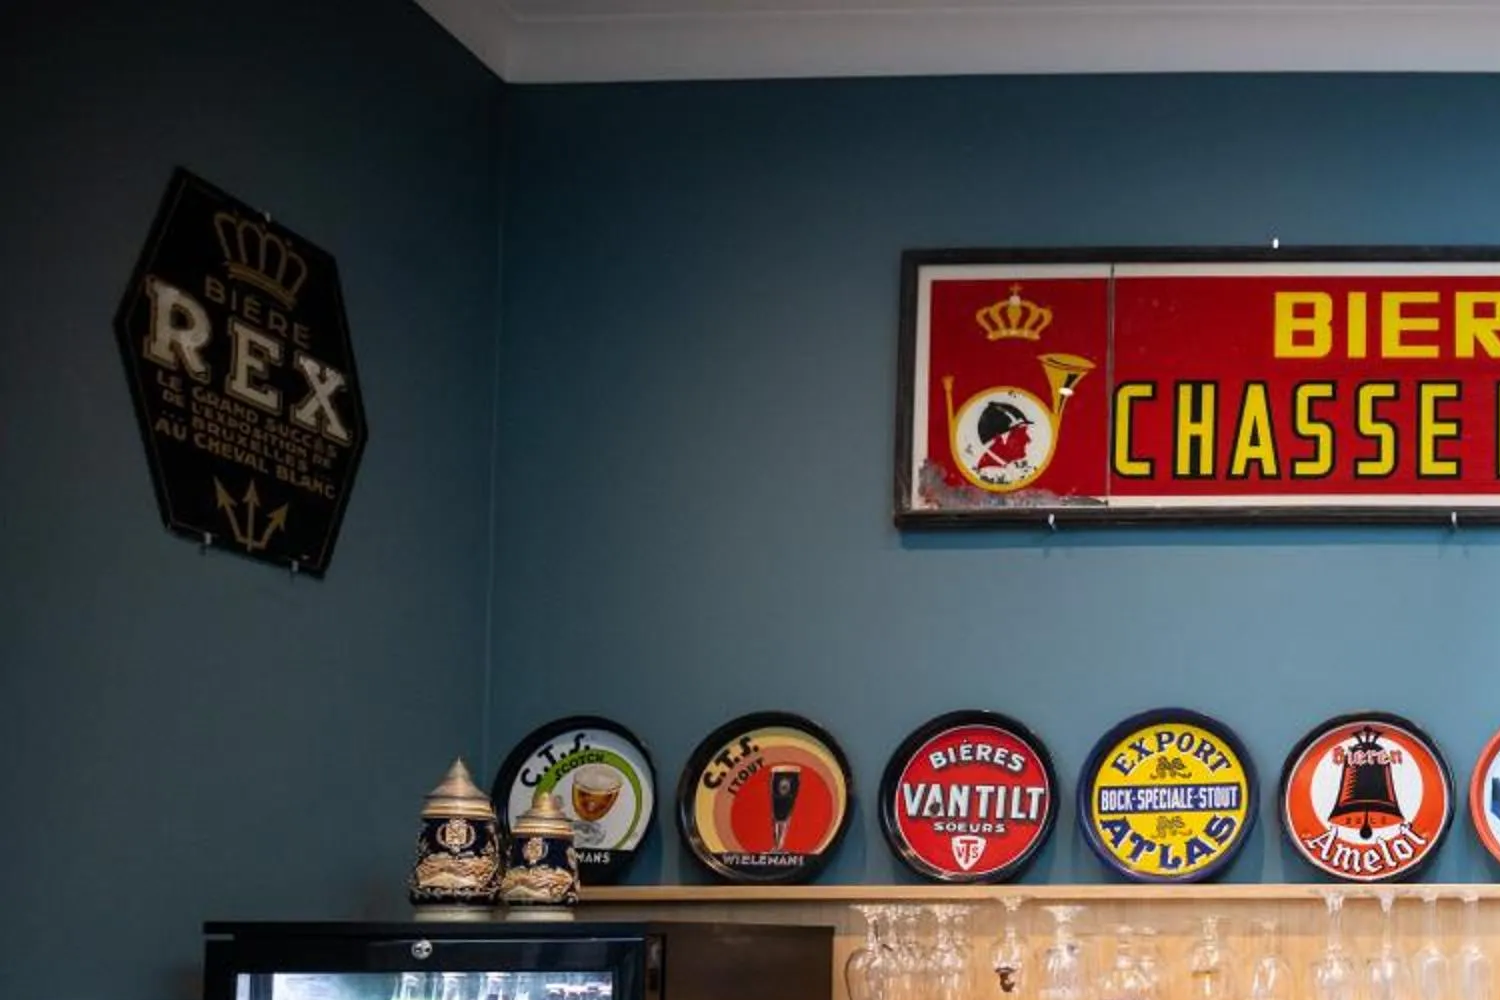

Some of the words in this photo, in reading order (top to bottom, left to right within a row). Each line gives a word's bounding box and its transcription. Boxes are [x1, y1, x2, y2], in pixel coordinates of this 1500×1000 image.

[143, 273, 353, 447] REX
[156, 370, 185, 394] LE
[191, 386, 259, 425] GRAND
[1110, 380, 1462, 481] CHASSE
[154, 417, 187, 442] AU
[192, 432, 269, 476] CHEVAL
[275, 464, 336, 500] BLANC
[1111, 732, 1232, 776] EXPORT
[933, 822, 1006, 833] SOEURS
[1100, 814, 1238, 870] ATLAS
[723, 853, 805, 866] WIELEMANS
